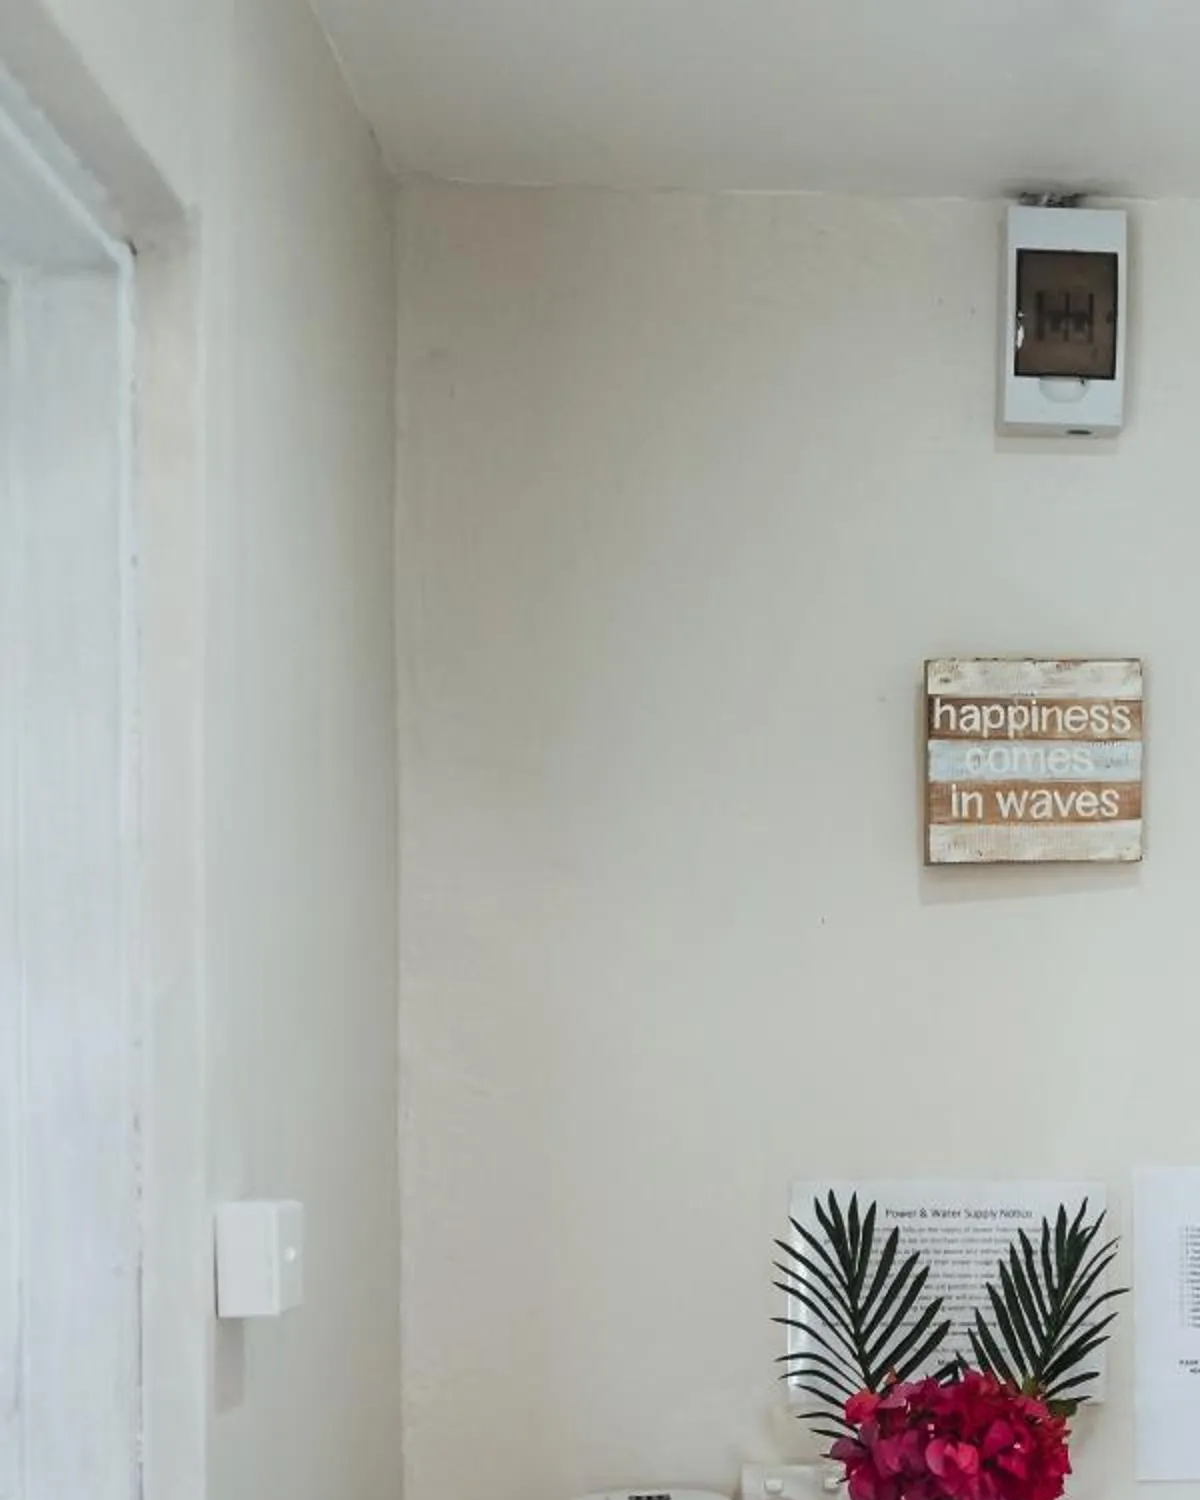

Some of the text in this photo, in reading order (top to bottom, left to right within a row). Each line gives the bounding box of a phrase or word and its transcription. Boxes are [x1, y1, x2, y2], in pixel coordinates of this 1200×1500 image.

[932, 696, 1133, 740] happiness
[965, 746, 1095, 775] comes
[951, 783, 1121, 820] in waves
[919, 1207, 928, 1218] &
[931, 1208, 961, 1219] Water
